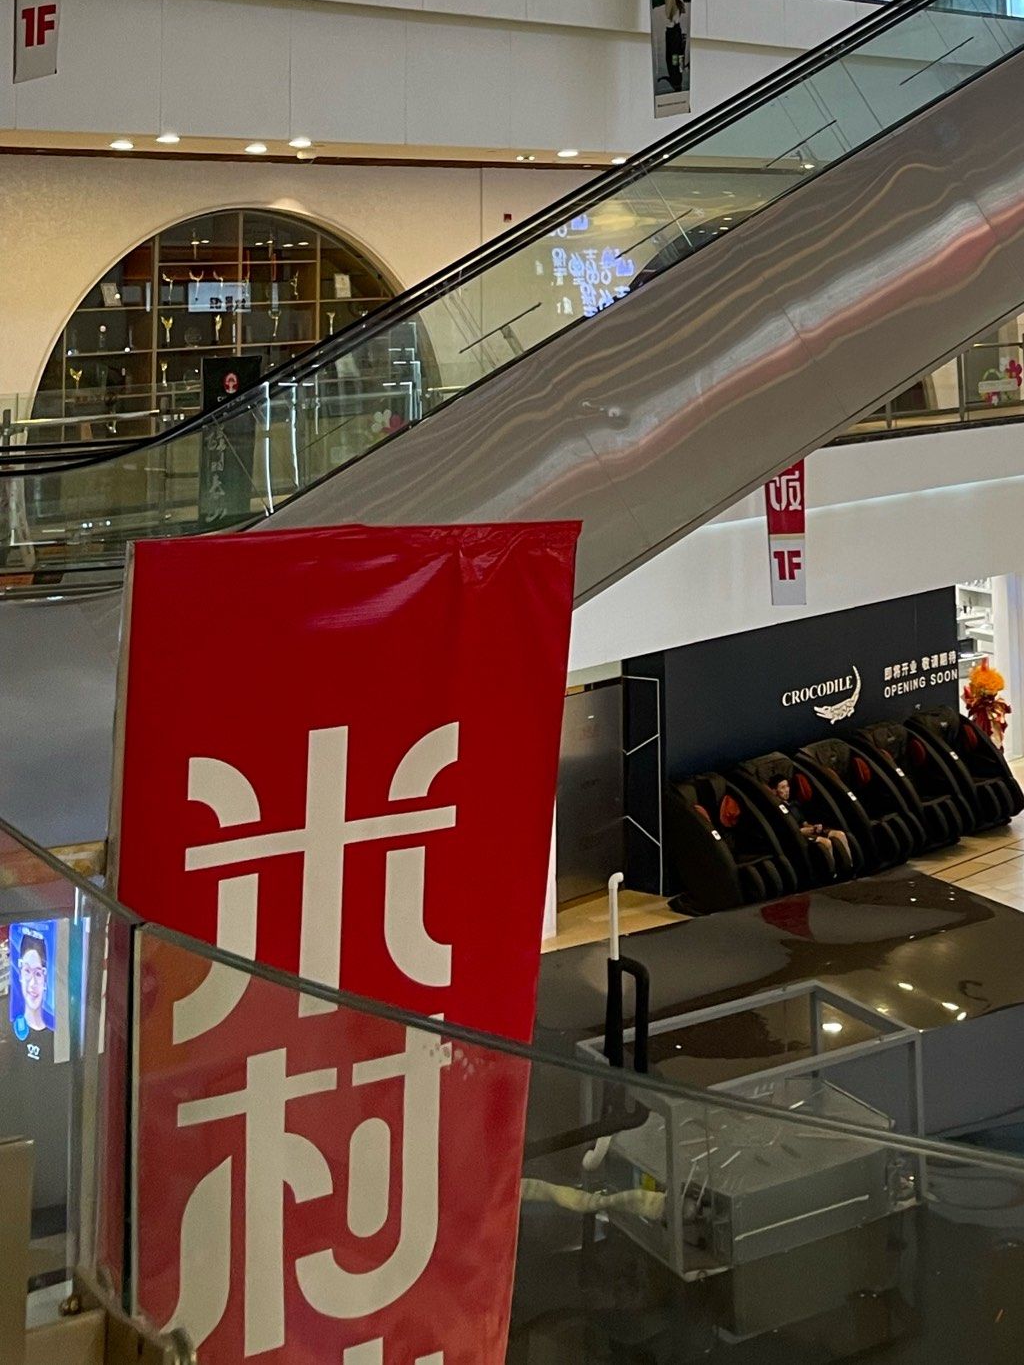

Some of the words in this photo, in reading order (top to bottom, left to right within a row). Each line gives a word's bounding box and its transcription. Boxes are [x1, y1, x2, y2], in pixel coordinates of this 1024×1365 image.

[21, 4, 57, 48] 1F
[773, 550, 802, 581] 1F
[781, 675, 854, 707] CROCODILE
[884, 675, 927, 699] OPENING
[930, 668, 958, 686] SOON
[160, 721, 461, 1365] 米村
